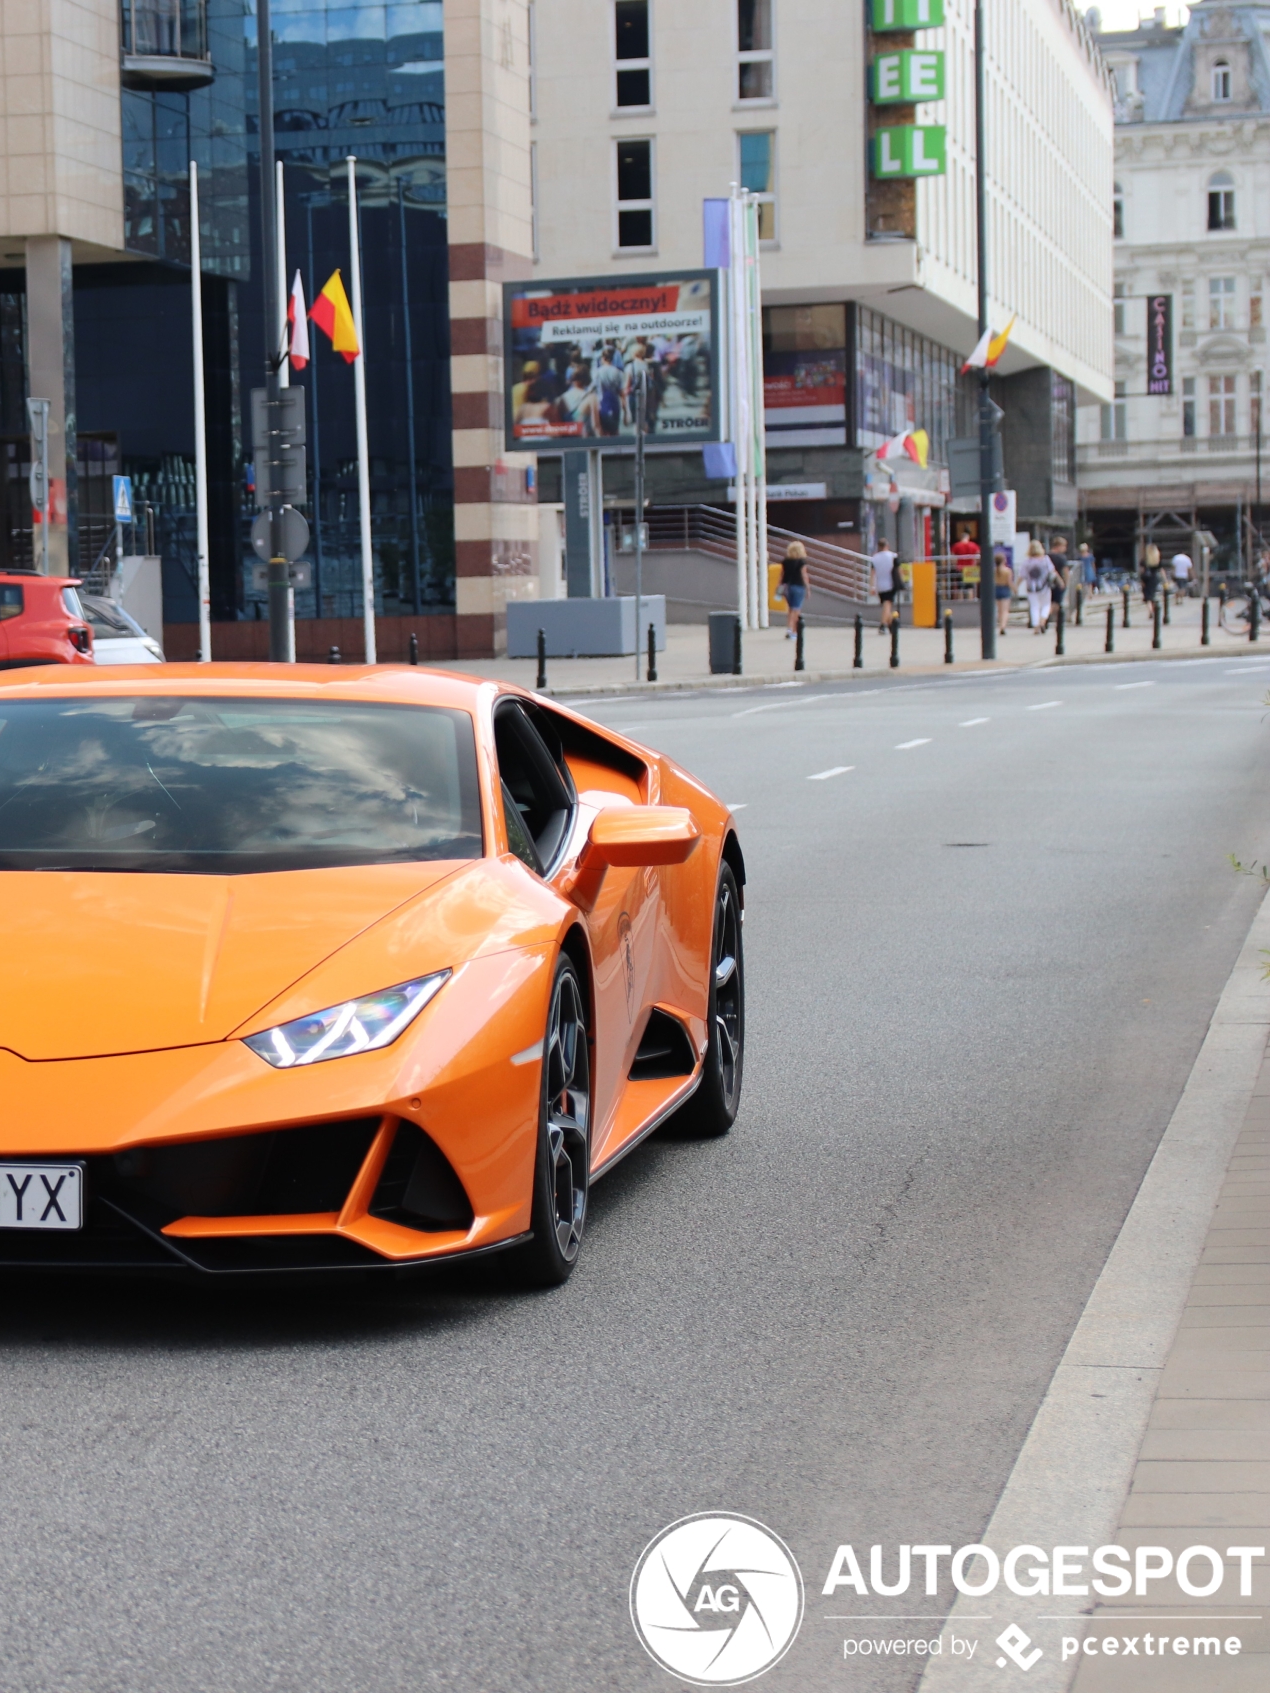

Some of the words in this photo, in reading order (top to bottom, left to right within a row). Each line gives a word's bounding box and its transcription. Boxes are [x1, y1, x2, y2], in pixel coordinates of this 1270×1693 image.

[527, 301, 571, 321] Bądź
[575, 293, 668, 314] widoczny!
[552, 321, 603, 337] Reklamuj
[605, 322, 620, 335] się
[625, 322, 638, 332] na
[641, 316, 704, 330] outdoorze!
[1152, 296, 1168, 379] CASINO
